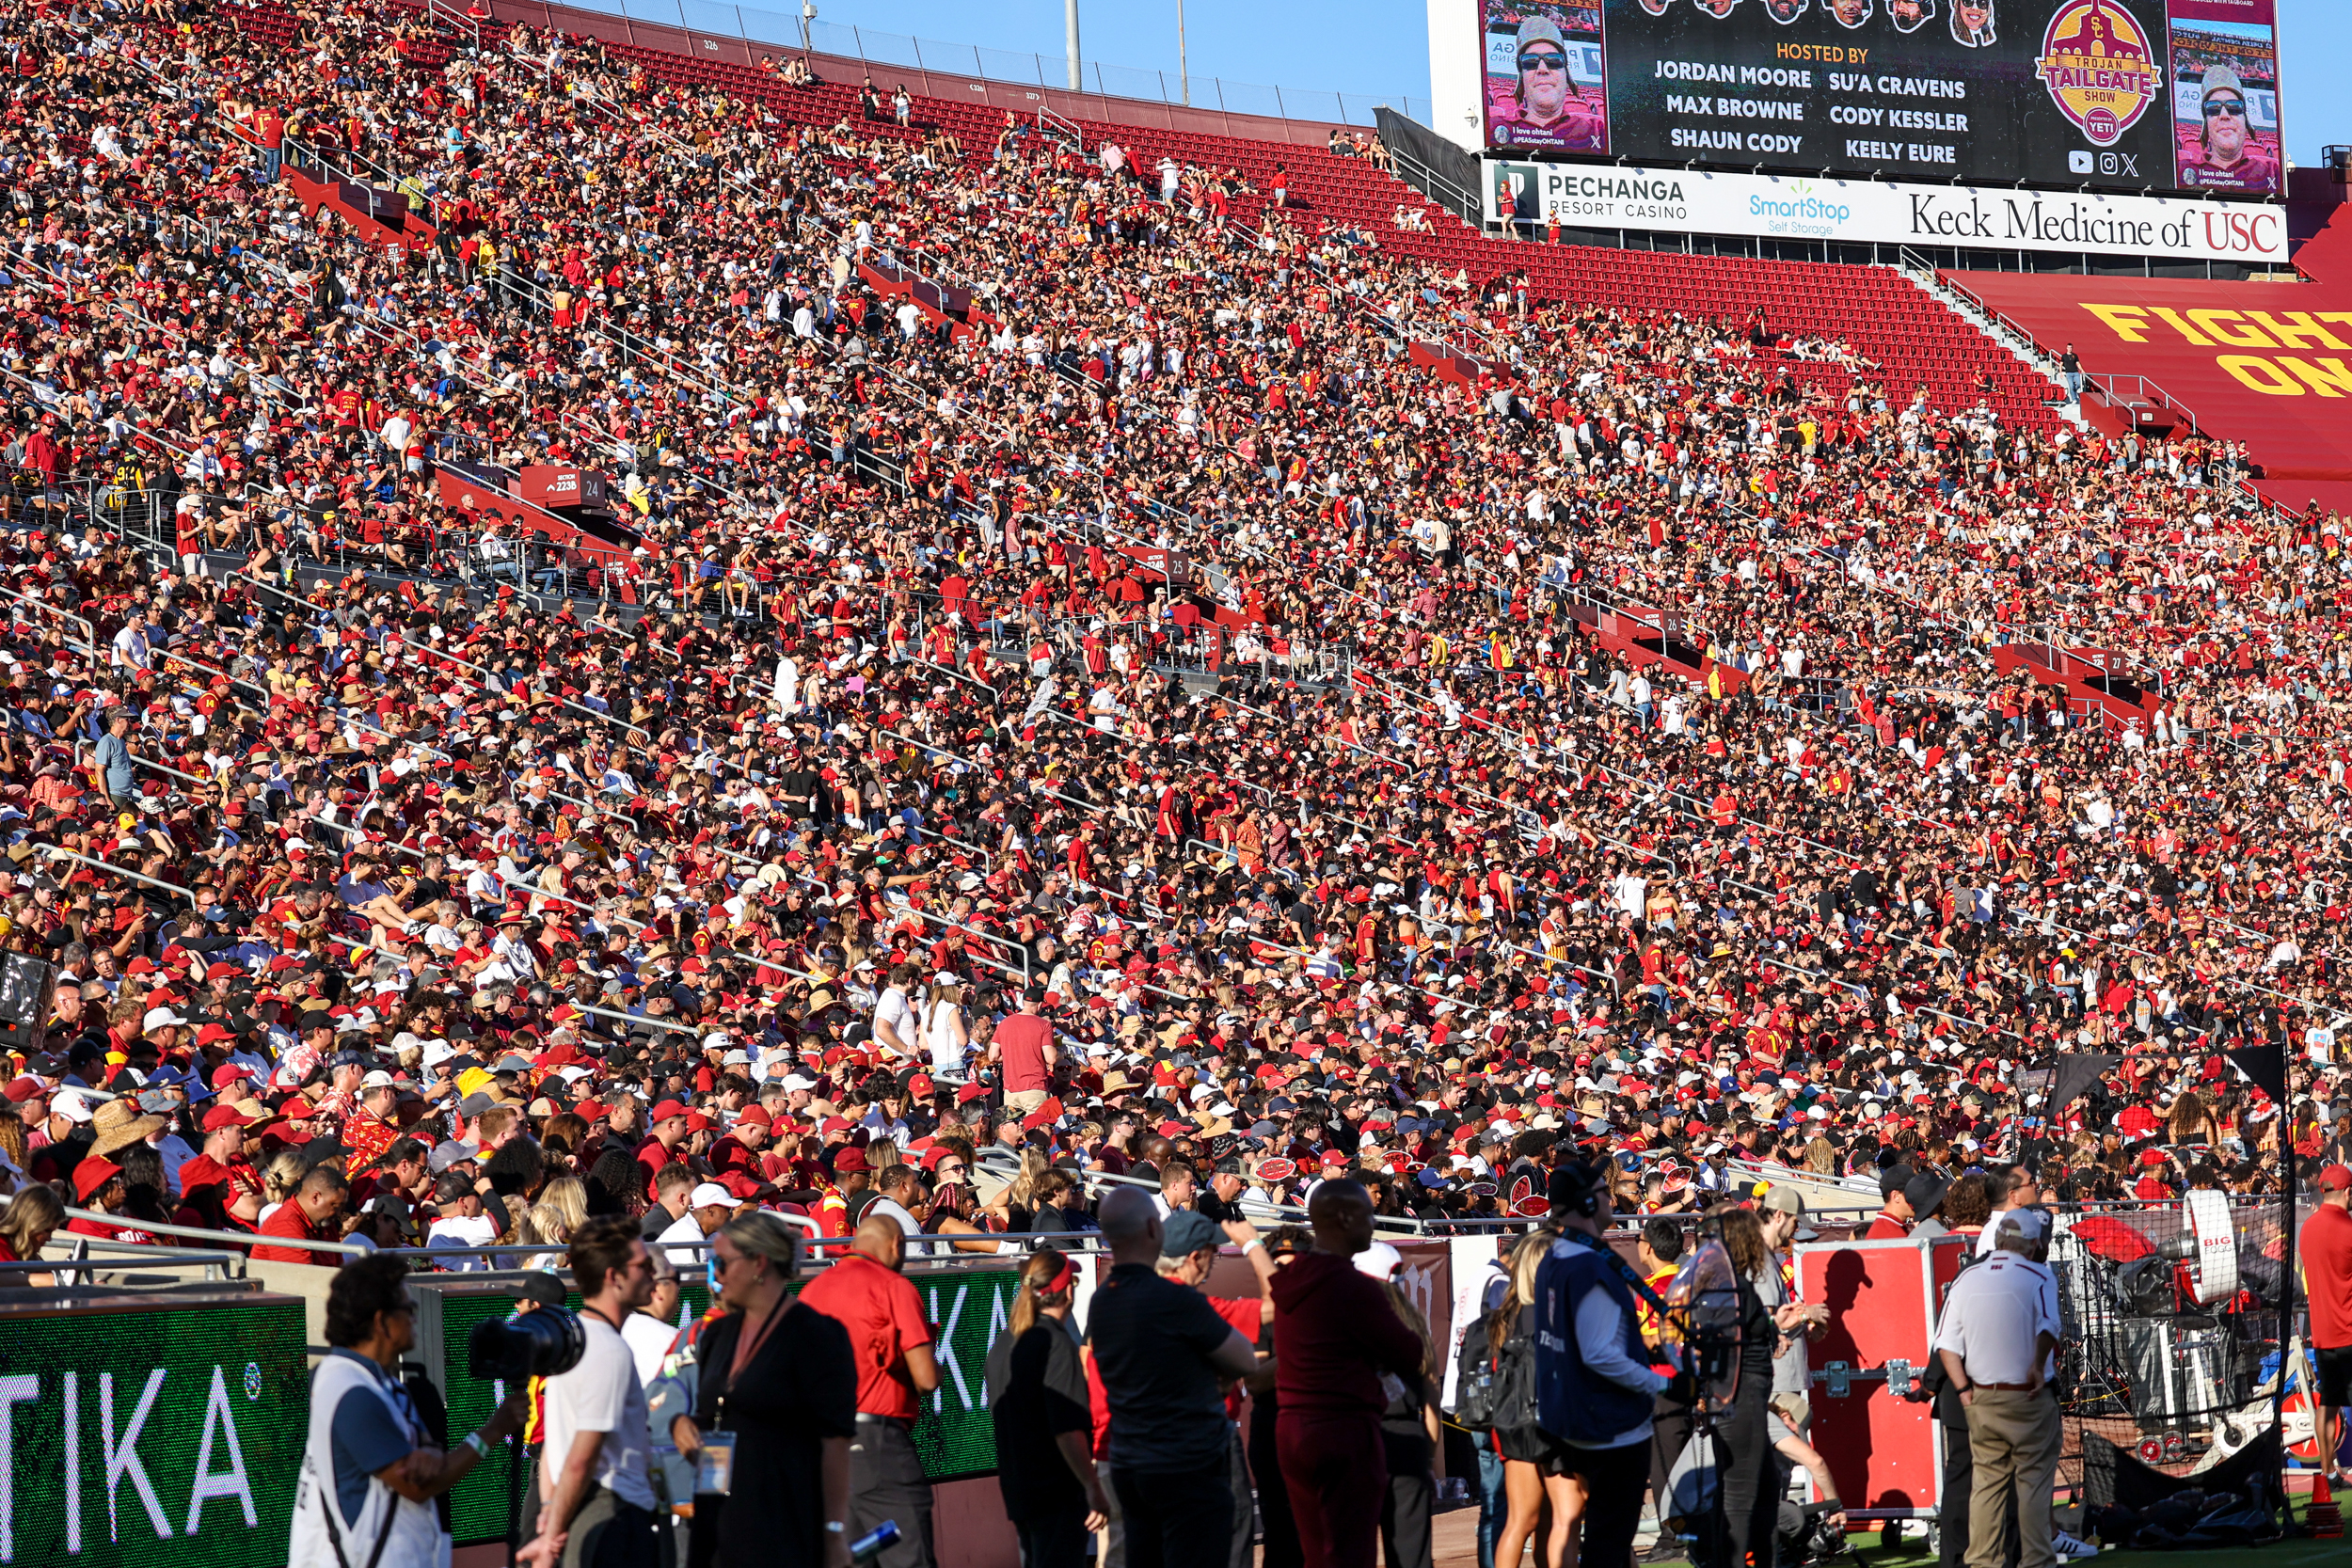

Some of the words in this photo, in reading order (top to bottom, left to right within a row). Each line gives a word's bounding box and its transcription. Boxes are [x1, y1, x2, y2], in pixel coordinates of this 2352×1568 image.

[704, 40, 719, 52] 326
[1776, 42, 1844, 63] HOSTED
[1849, 48, 1868, 64] BY
[2074, 57, 2122, 70] TROJAN
[1654, 60, 1735, 83] JORDAN
[1740, 66, 1812, 88] MOORE
[974, 84, 984, 92] 326
[1829, 72, 1873, 93] SU'A
[1877, 76, 1965, 99] CRAVENS
[2044, 66, 2153, 98] TAILGATE
[2084, 90, 2116, 103] SHOW
[1666, 94, 1713, 116] MAX
[1717, 98, 1804, 121] BROWNE
[1829, 106, 1884, 127] CODY
[1889, 109, 1969, 132] KESSLER
[1517, 127, 1531, 135] love
[1532, 128, 1553, 136] ohtani
[2090, 122, 2114, 133] YETI
[1671, 128, 1741, 150] SHAUN
[1746, 133, 1803, 154] CODY
[1846, 139, 1903, 161] KEELY
[1908, 144, 1956, 164] EURE
[2215, 170, 2234, 179] ohtani
[1549, 176, 1685, 202] PECHANGA
[1550, 200, 1614, 216] RESORT
[1625, 204, 1687, 220] CASINO
[1749, 195, 1850, 225] SmartStop
[1769, 220, 1788, 233] Self
[1791, 221, 1834, 237] Storage
[1909, 193, 1994, 238] Keck
[2003, 198, 2153, 245] Medicine
[2161, 209, 2196, 248] of
[2201, 211, 2279, 252] USC
[557, 473, 576, 482] SECTION
[556, 481, 578, 492] 223B
[586, 481, 598, 498] 24
[1172, 560, 1184, 575] 25
[1668, 619, 1677, 631] 26
[2112, 657, 2122, 669] 27
[205, 699, 215, 708] 14
[1832, 776, 1842, 790] 9
[699, 938, 706, 947] 7
[1094, 947, 1103, 957] 13
[1655, 957, 1659, 965] 1
[1749, 1037, 1755, 1046] 7
[1385, 1154, 1400, 1163] USC
[2203, 1236, 2232, 1247] BIG
[2204, 1244, 2233, 1255] FOGG
